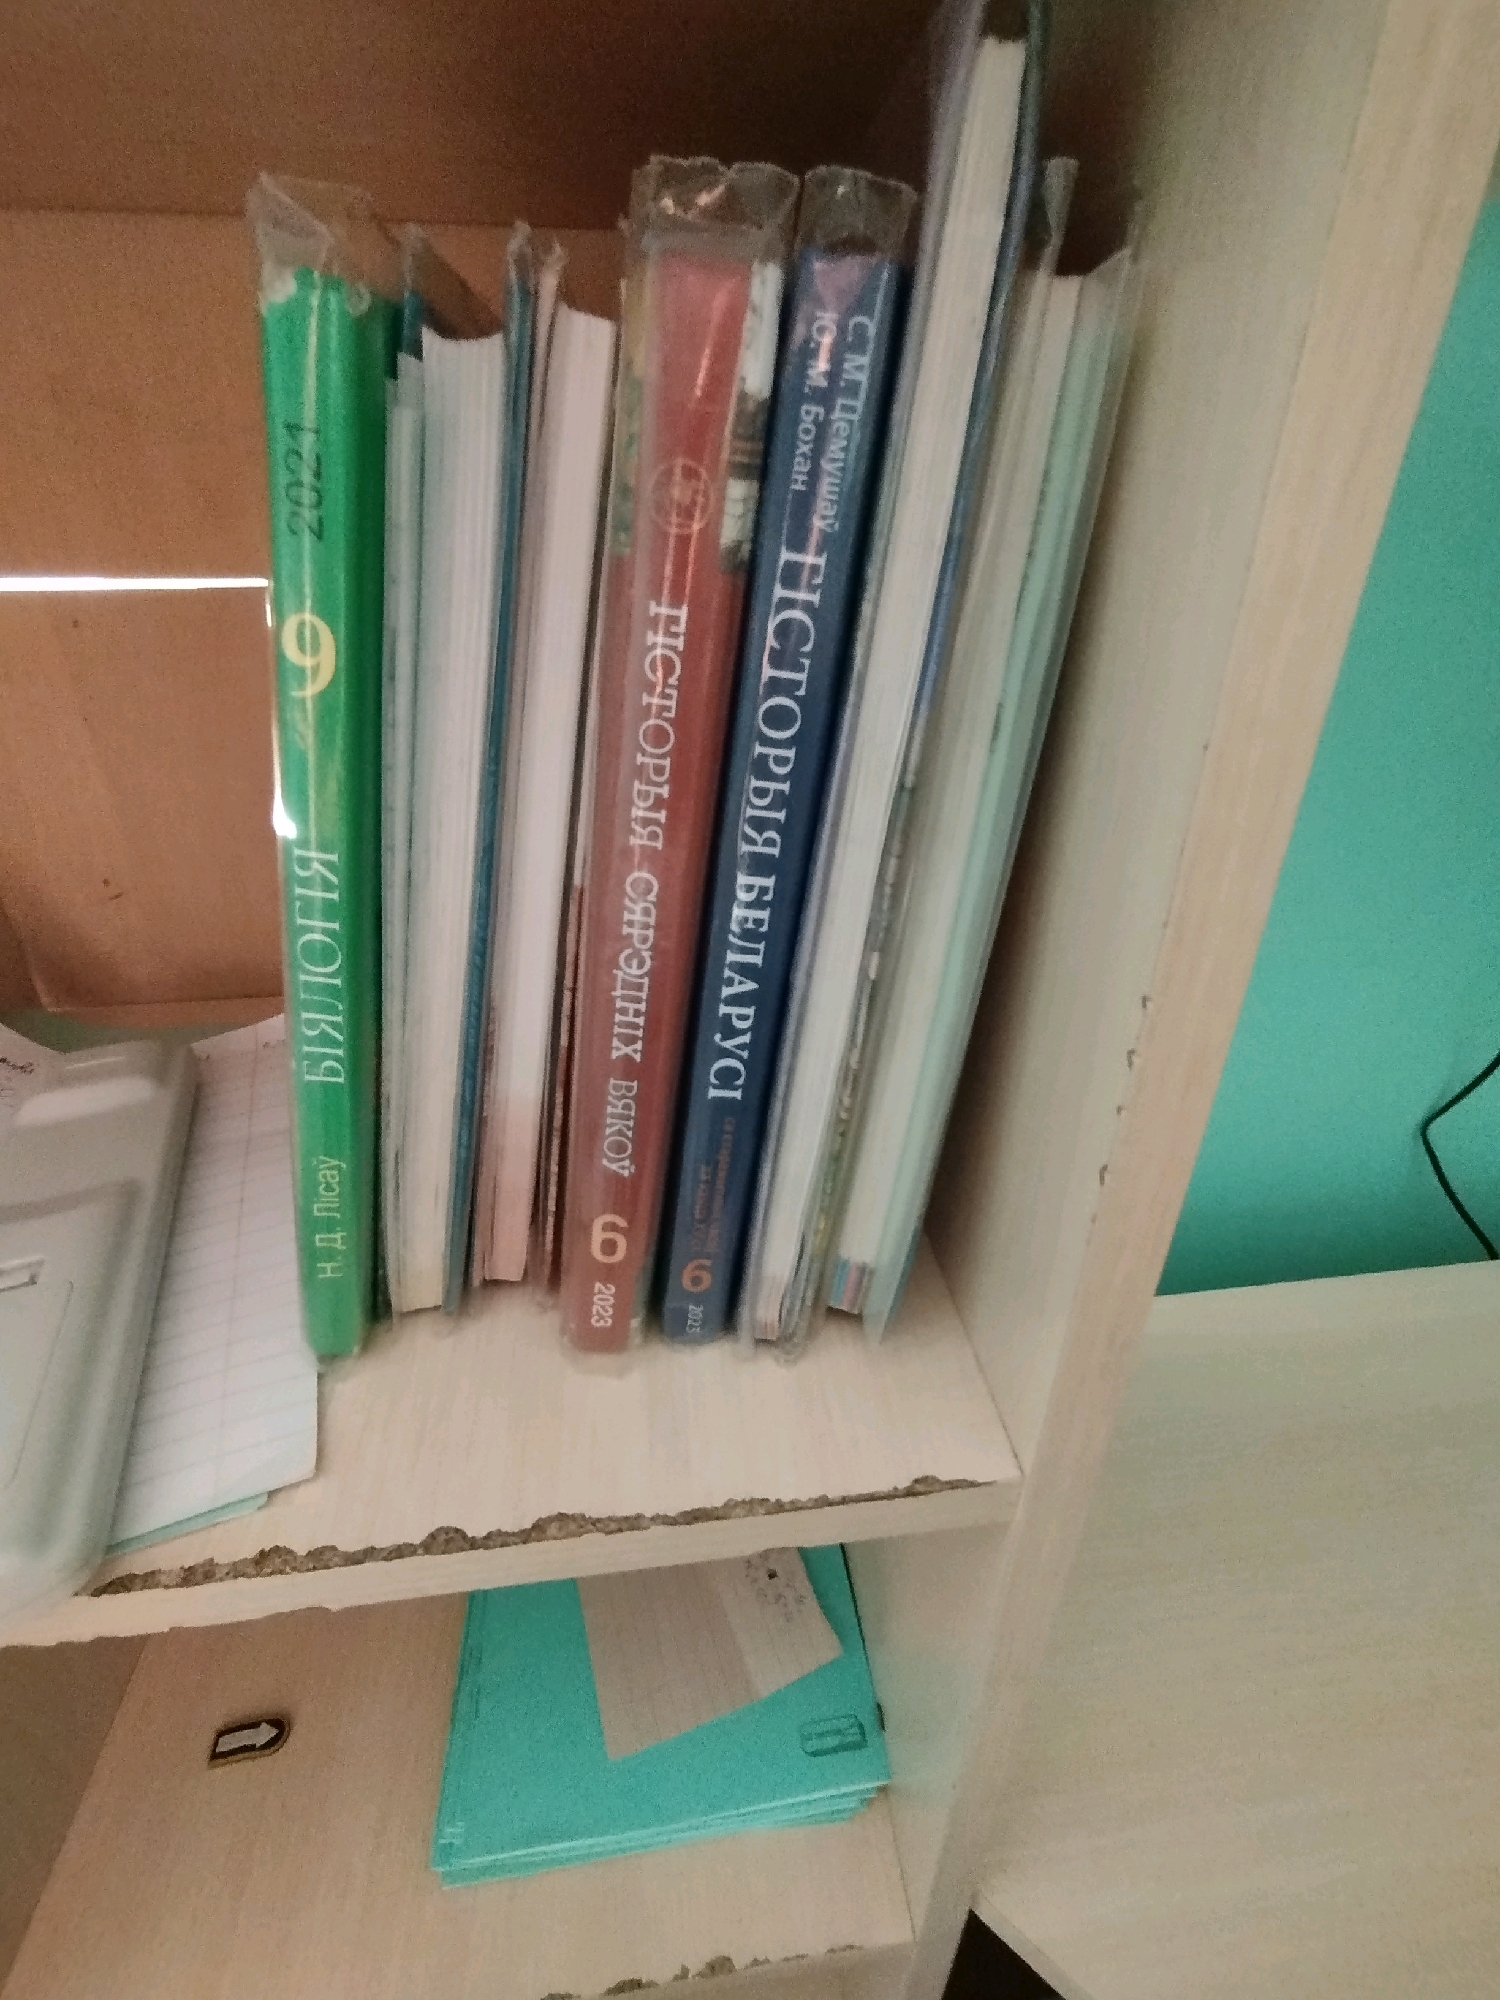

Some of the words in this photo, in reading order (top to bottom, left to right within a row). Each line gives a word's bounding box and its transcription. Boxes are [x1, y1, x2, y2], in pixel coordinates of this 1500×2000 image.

[811, 311, 839, 349] Ю.
[839, 353, 873, 387] М.
[804, 358, 832, 393] М.
[283, 419, 323, 541] 2021
[791, 404, 825, 491] Бохан
[812, 397, 862, 533] Цемушаў
[281, 612, 337, 697] 9
[629, 600, 689, 850] ГІСТОРЫЯ
[740, 549, 828, 859] ГІСТОРЫЯ
[294, 848, 346, 1084] БІЯЛОГІЯ
[611, 871, 660, 1063] СЯРЭДНІХ
[708, 872, 776, 1101] БЕЛАРУСІ
[602, 1077, 638, 1177] ВЯКОЎ
[311, 1155, 347, 1219] Лісаў
[315, 1227, 347, 1249] Д.
[316, 1256, 344, 1278] Н.
[591, 1213, 629, 1263] 6
[681, 1258, 712, 1293] 6
[591, 1281, 616, 1328] 2023
